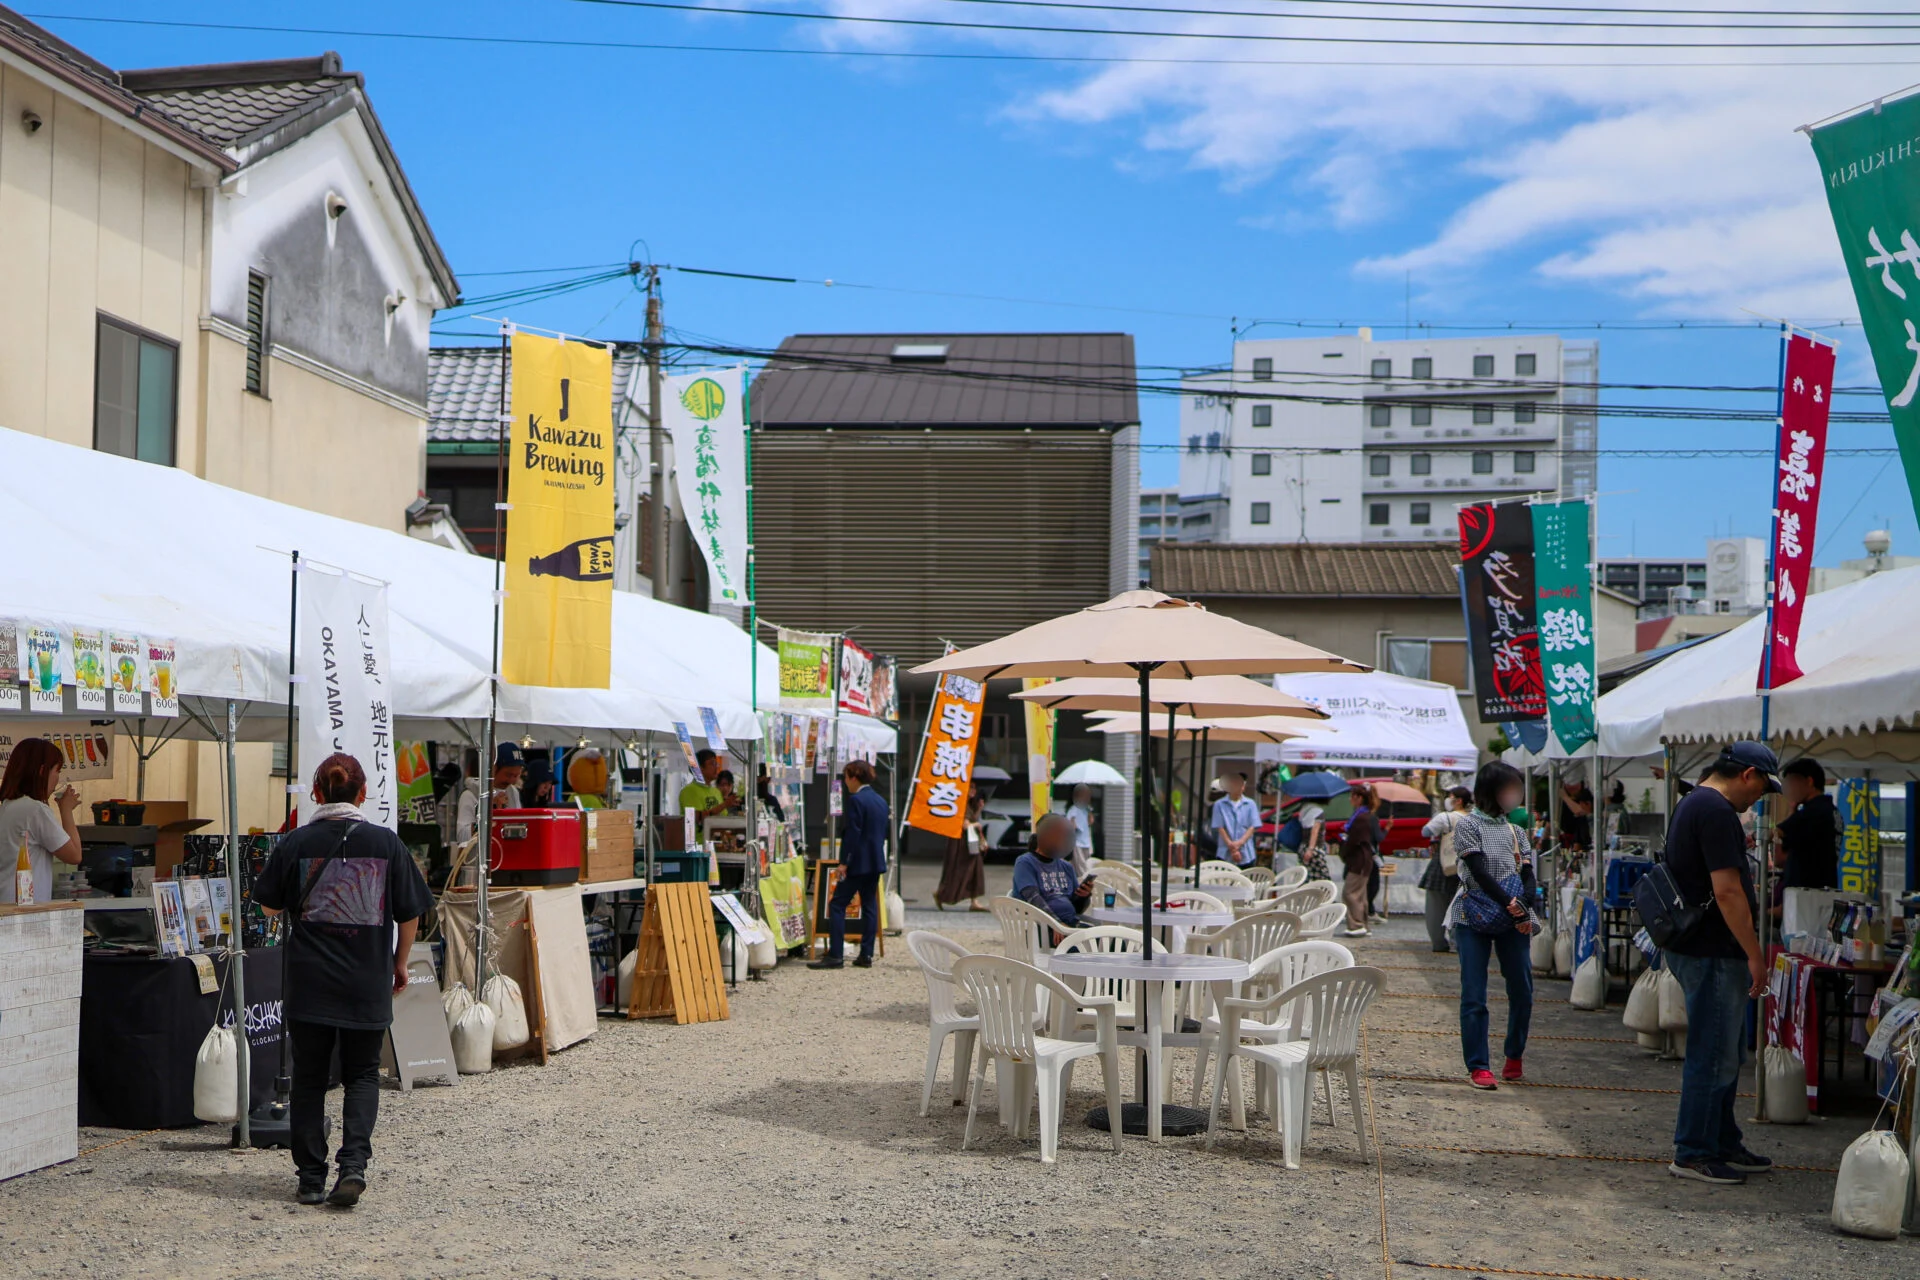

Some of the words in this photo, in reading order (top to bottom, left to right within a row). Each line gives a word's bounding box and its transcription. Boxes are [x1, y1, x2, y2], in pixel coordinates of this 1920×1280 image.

[528, 413, 605, 451] Kawazu
[524, 442, 605, 487] Brewing
[589, 541, 601, 575] KAWA
[602, 551, 613, 569] ZU
[321, 626, 344, 731] OKAYAMA
[82, 691, 105, 703] 600円
[119, 693, 141, 705] 600円
[156, 697, 178, 709] 600円
[1326, 696, 1447, 719] 笹川スポーツ財団
[1842, 781, 1880, 895] 休憩所
